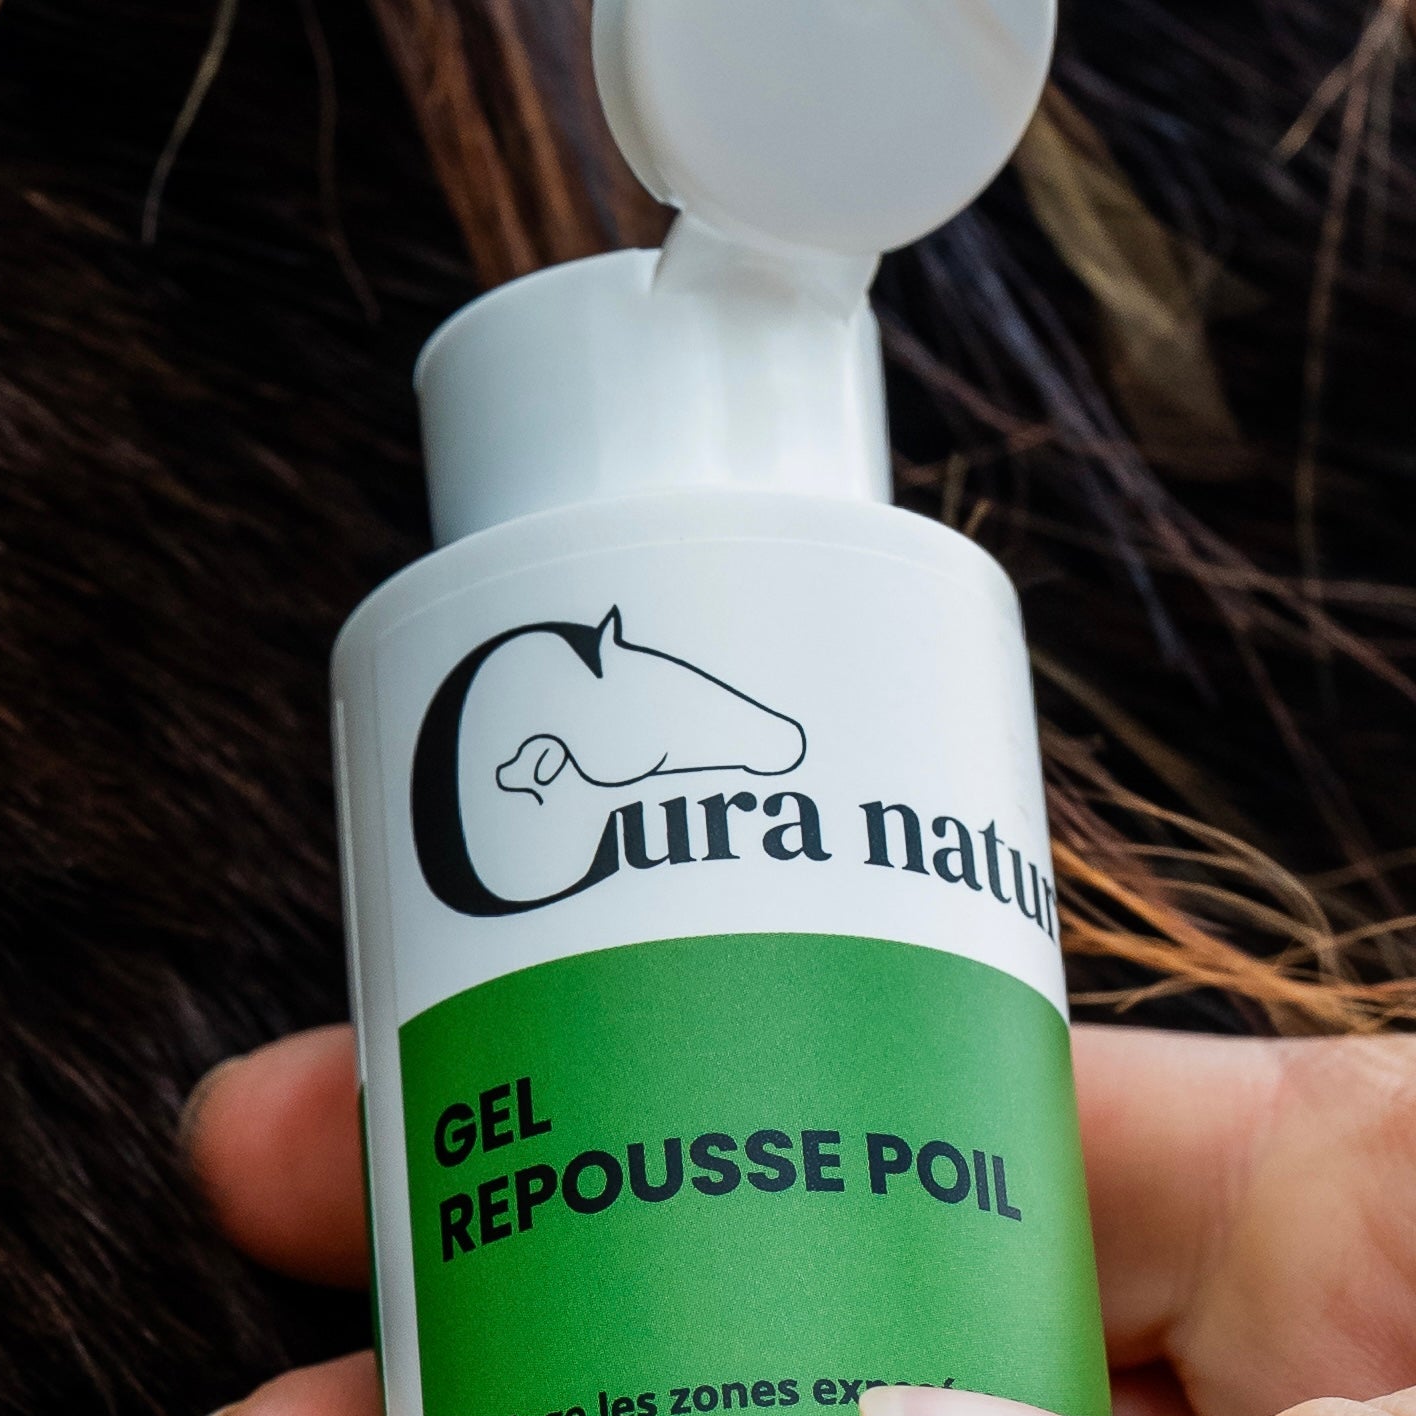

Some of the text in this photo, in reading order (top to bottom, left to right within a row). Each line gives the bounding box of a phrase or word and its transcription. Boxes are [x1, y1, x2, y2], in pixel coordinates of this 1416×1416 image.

[410, 620, 832, 917] Cura
[434, 1077, 552, 1168] GEL
[440, 1129, 1022, 1262] REPOUSSE POIL
[669, 1378, 800, 1416] zones
